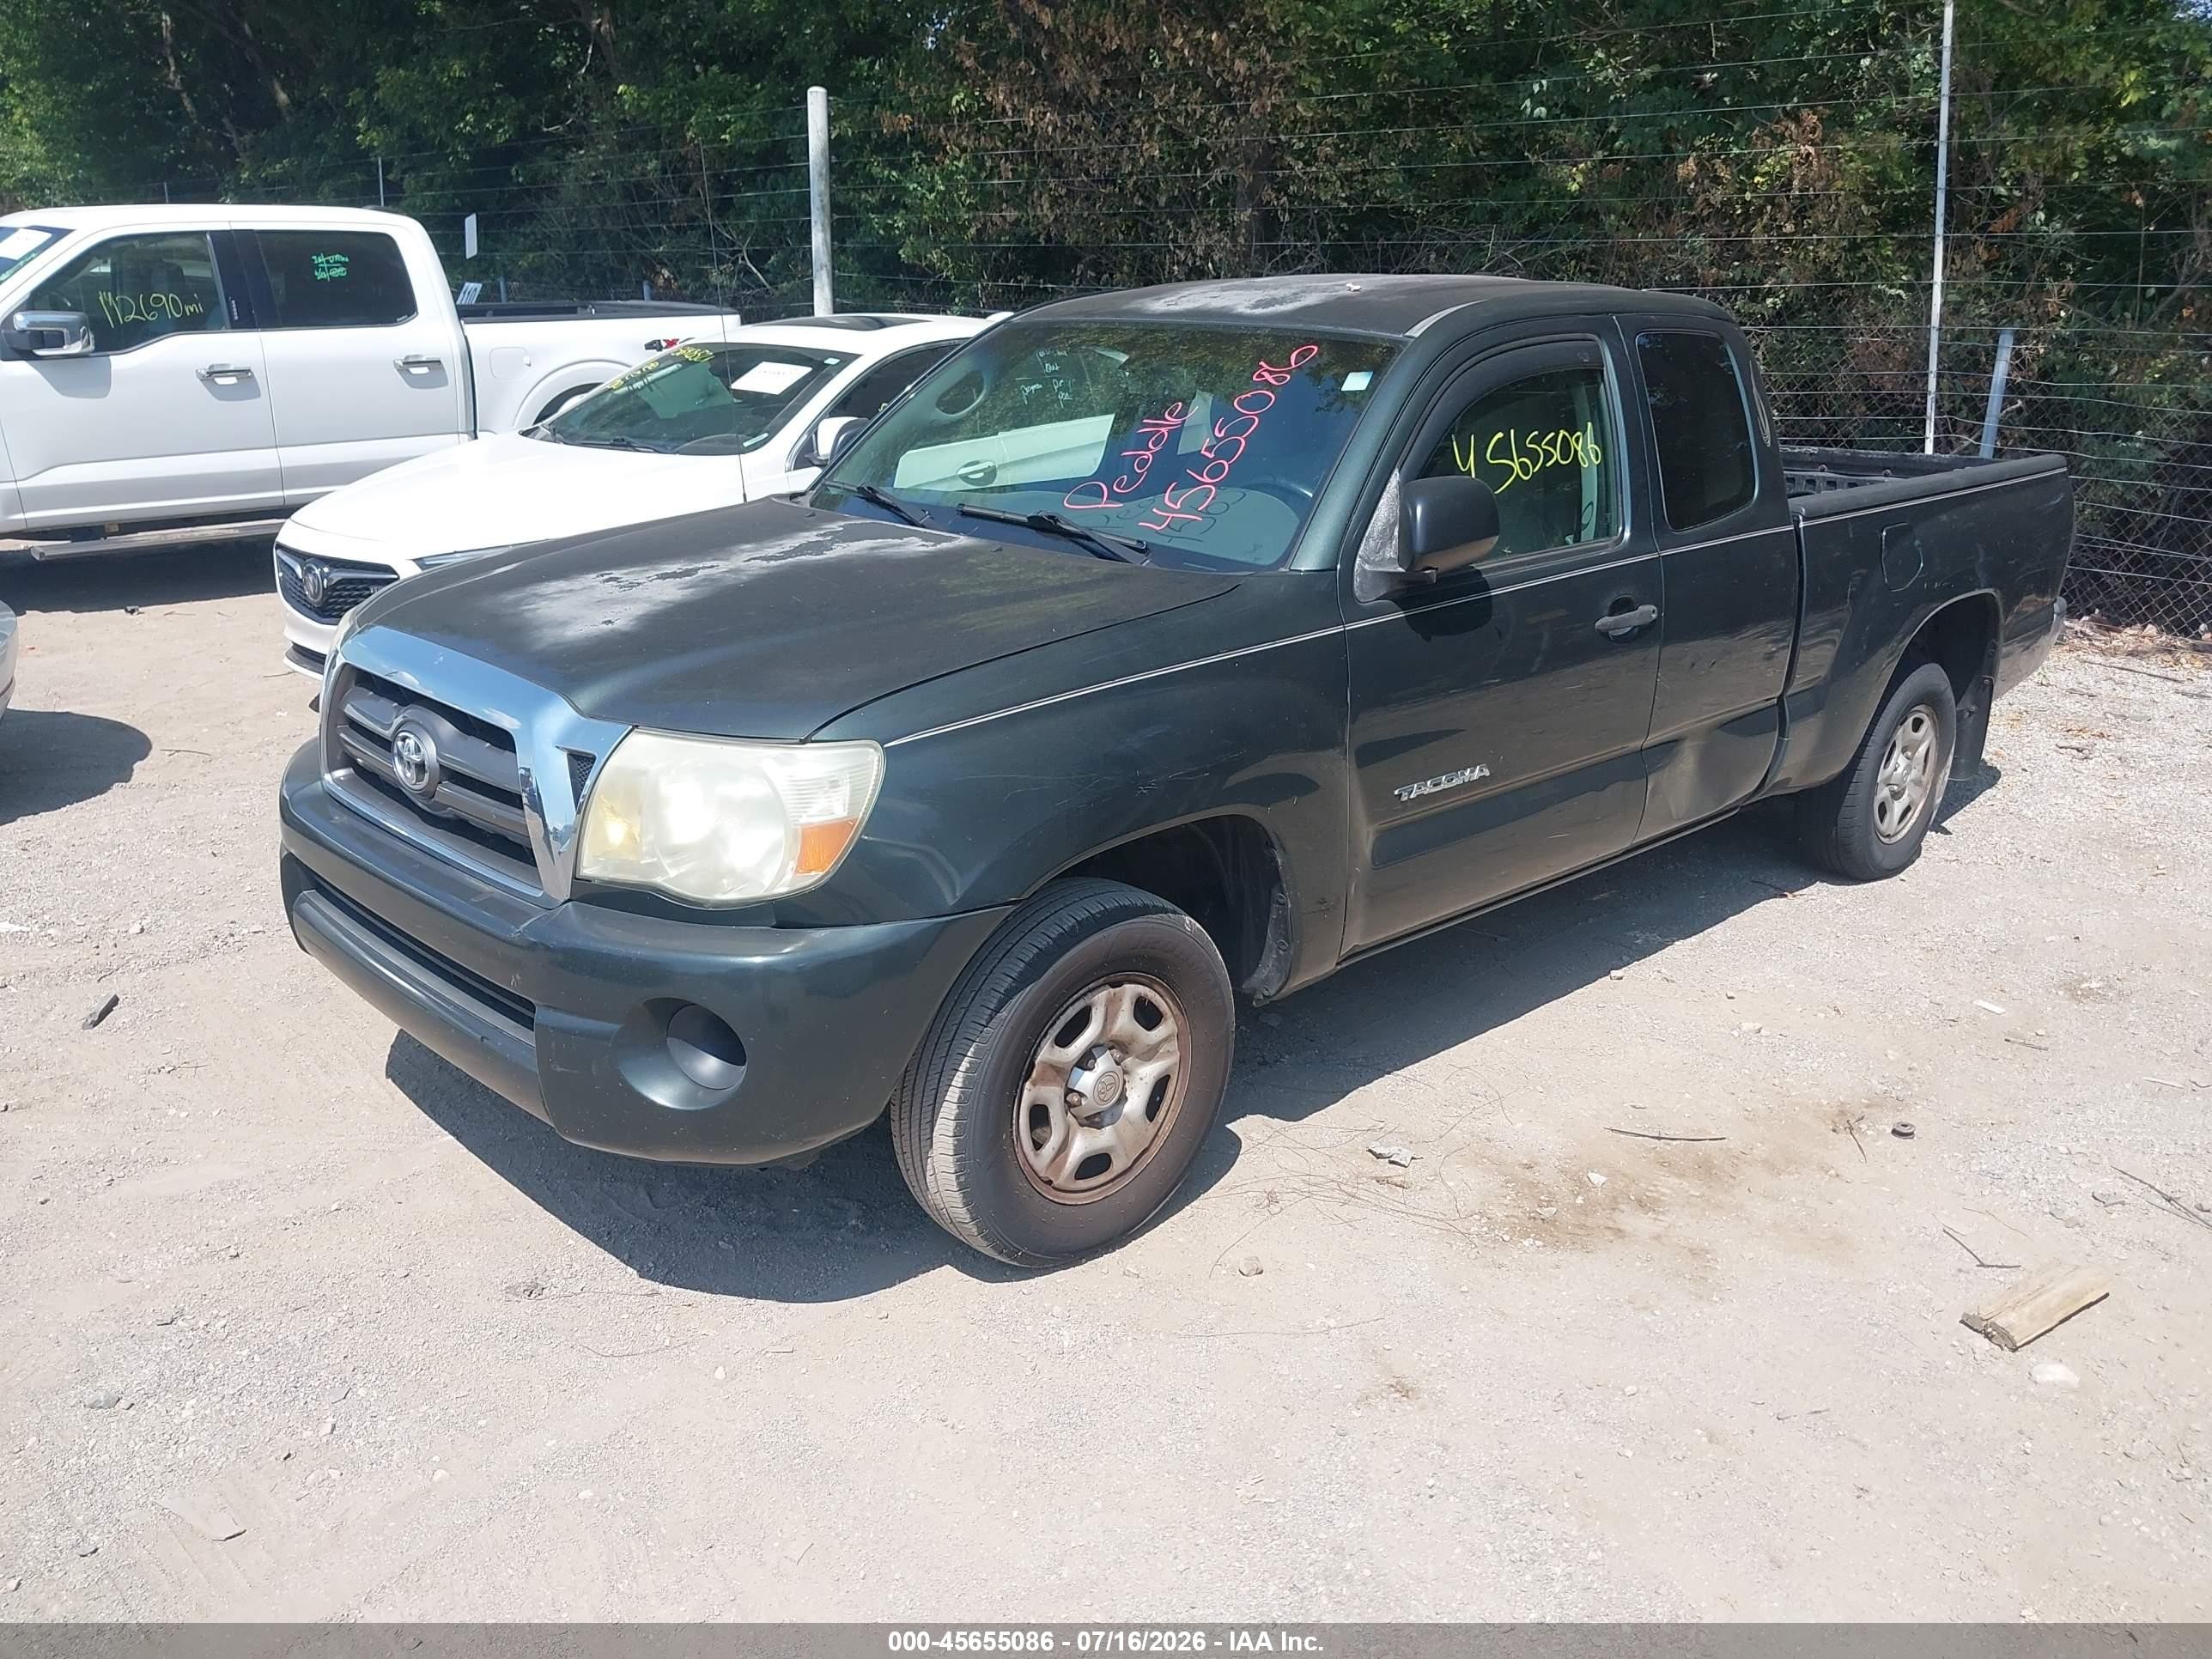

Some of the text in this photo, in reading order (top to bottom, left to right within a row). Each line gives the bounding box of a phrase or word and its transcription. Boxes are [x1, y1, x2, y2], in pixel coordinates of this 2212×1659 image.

[1063, 401, 1200, 509] Peddle
[1138, 344, 1319, 531] 45655086
[1394, 763, 1491, 802] TACOMA
